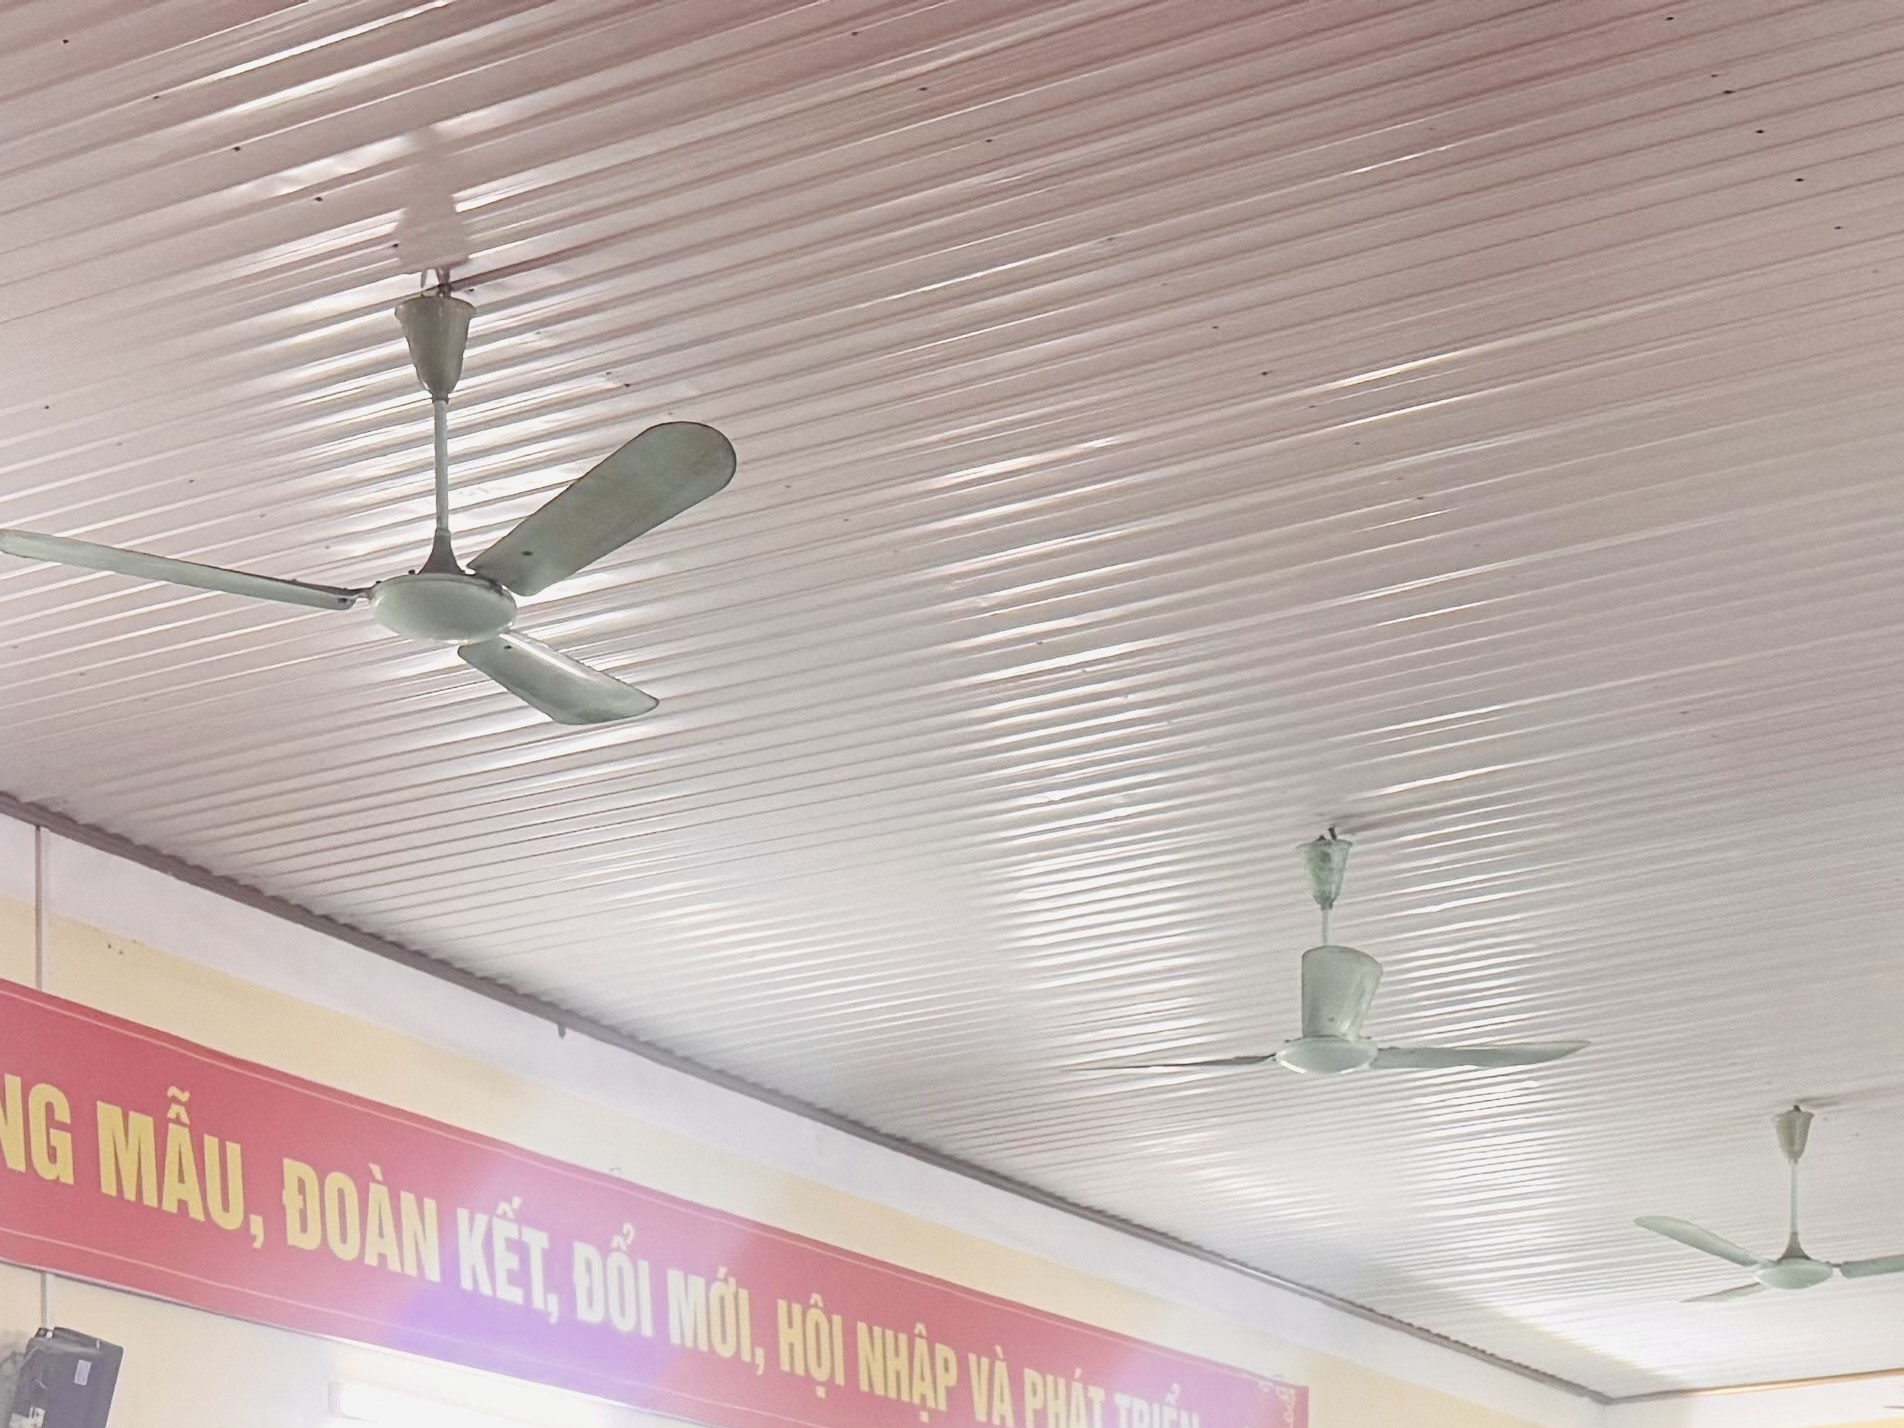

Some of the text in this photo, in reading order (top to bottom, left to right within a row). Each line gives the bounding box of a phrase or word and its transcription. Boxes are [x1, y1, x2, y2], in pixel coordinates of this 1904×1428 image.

[96, 1086, 265, 1250] MẪU,
[282, 1161, 441, 1283] ĐOÀN
[456, 1196, 560, 1324] KẾT,
[571, 1222, 654, 1338] ĐỔI
[666, 1267, 765, 1376] MỚI,
[776, 1293, 846, 1398] HỘI
[856, 1321, 959, 1424] NHẬP
